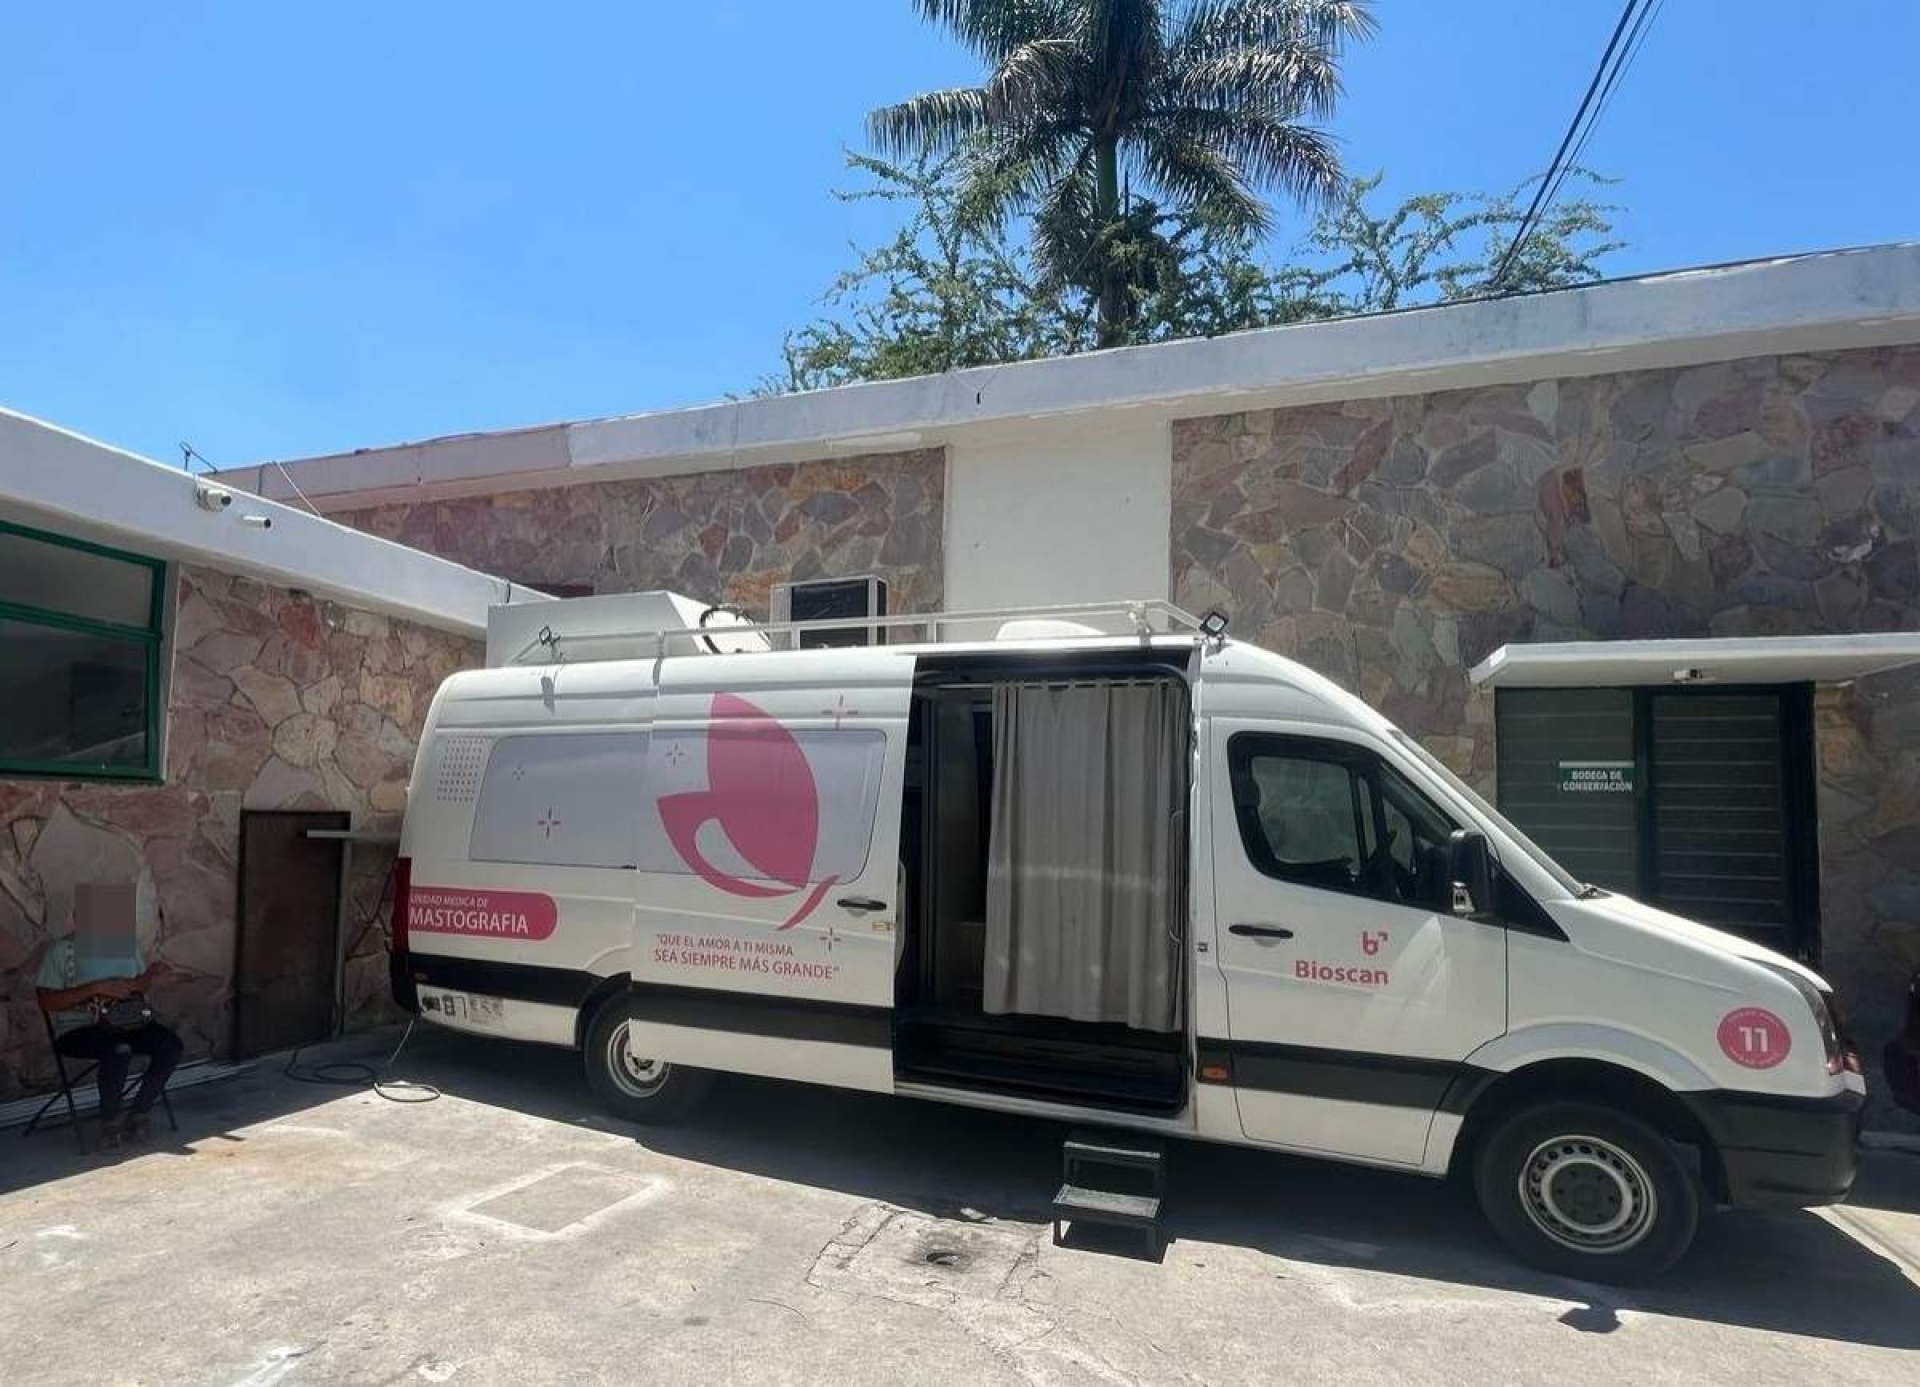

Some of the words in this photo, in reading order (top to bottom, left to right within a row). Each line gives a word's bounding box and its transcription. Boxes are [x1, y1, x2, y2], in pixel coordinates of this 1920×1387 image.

[409, 908, 528, 934] MASTOGRAFIA
[684, 935, 695, 948] EL
[697, 937, 730, 951] AMOR
[733, 939, 741, 952] A
[743, 941, 752, 953] TI
[754, 943, 793, 956] MISMA
[655, 949, 678, 963] SEA
[681, 951, 736, 970] SIEMPRE
[1295, 960, 1389, 985] Bioscan
[1739, 1026, 1768, 1053] 11
